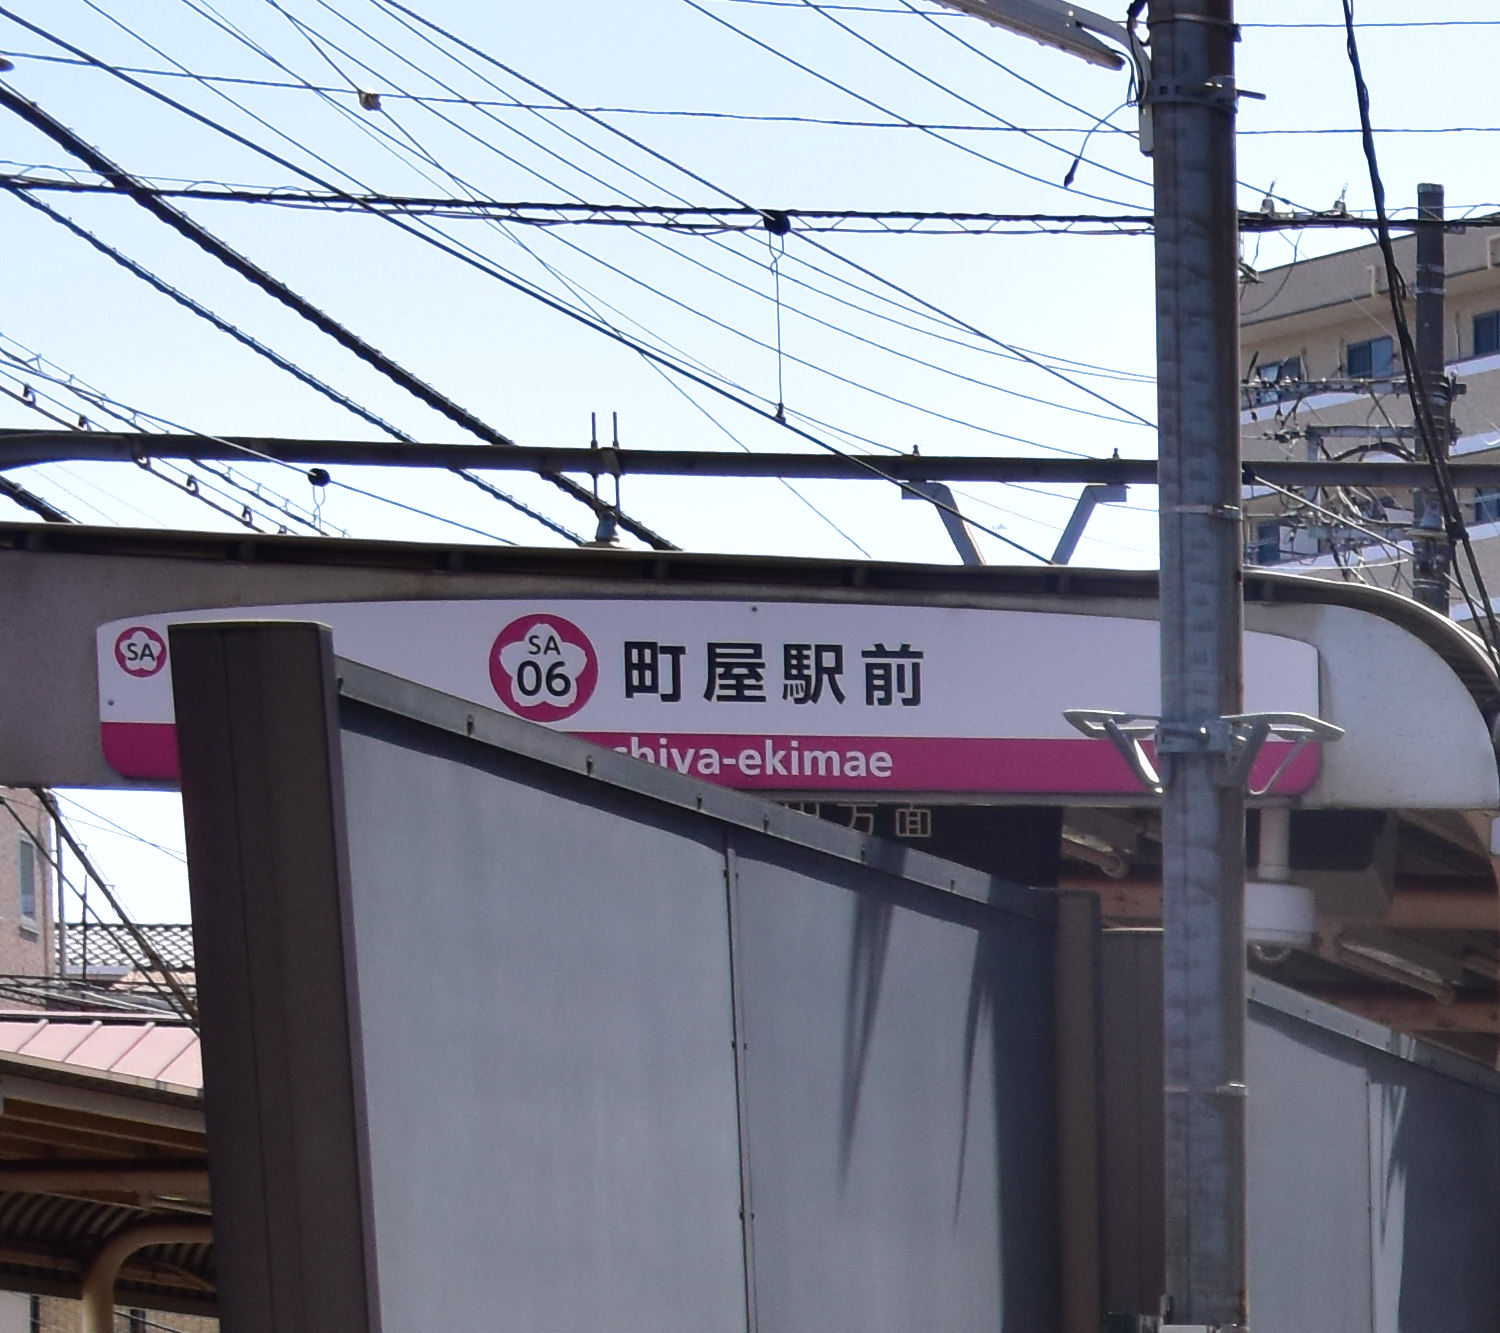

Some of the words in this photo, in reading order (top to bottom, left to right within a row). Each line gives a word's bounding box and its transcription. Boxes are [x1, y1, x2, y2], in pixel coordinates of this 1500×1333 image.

[126, 641, 156, 661] SA
[528, 622, 561, 654] SA
[517, 661, 571, 698] 06
[622, 640, 925, 708] 町屋駅前
